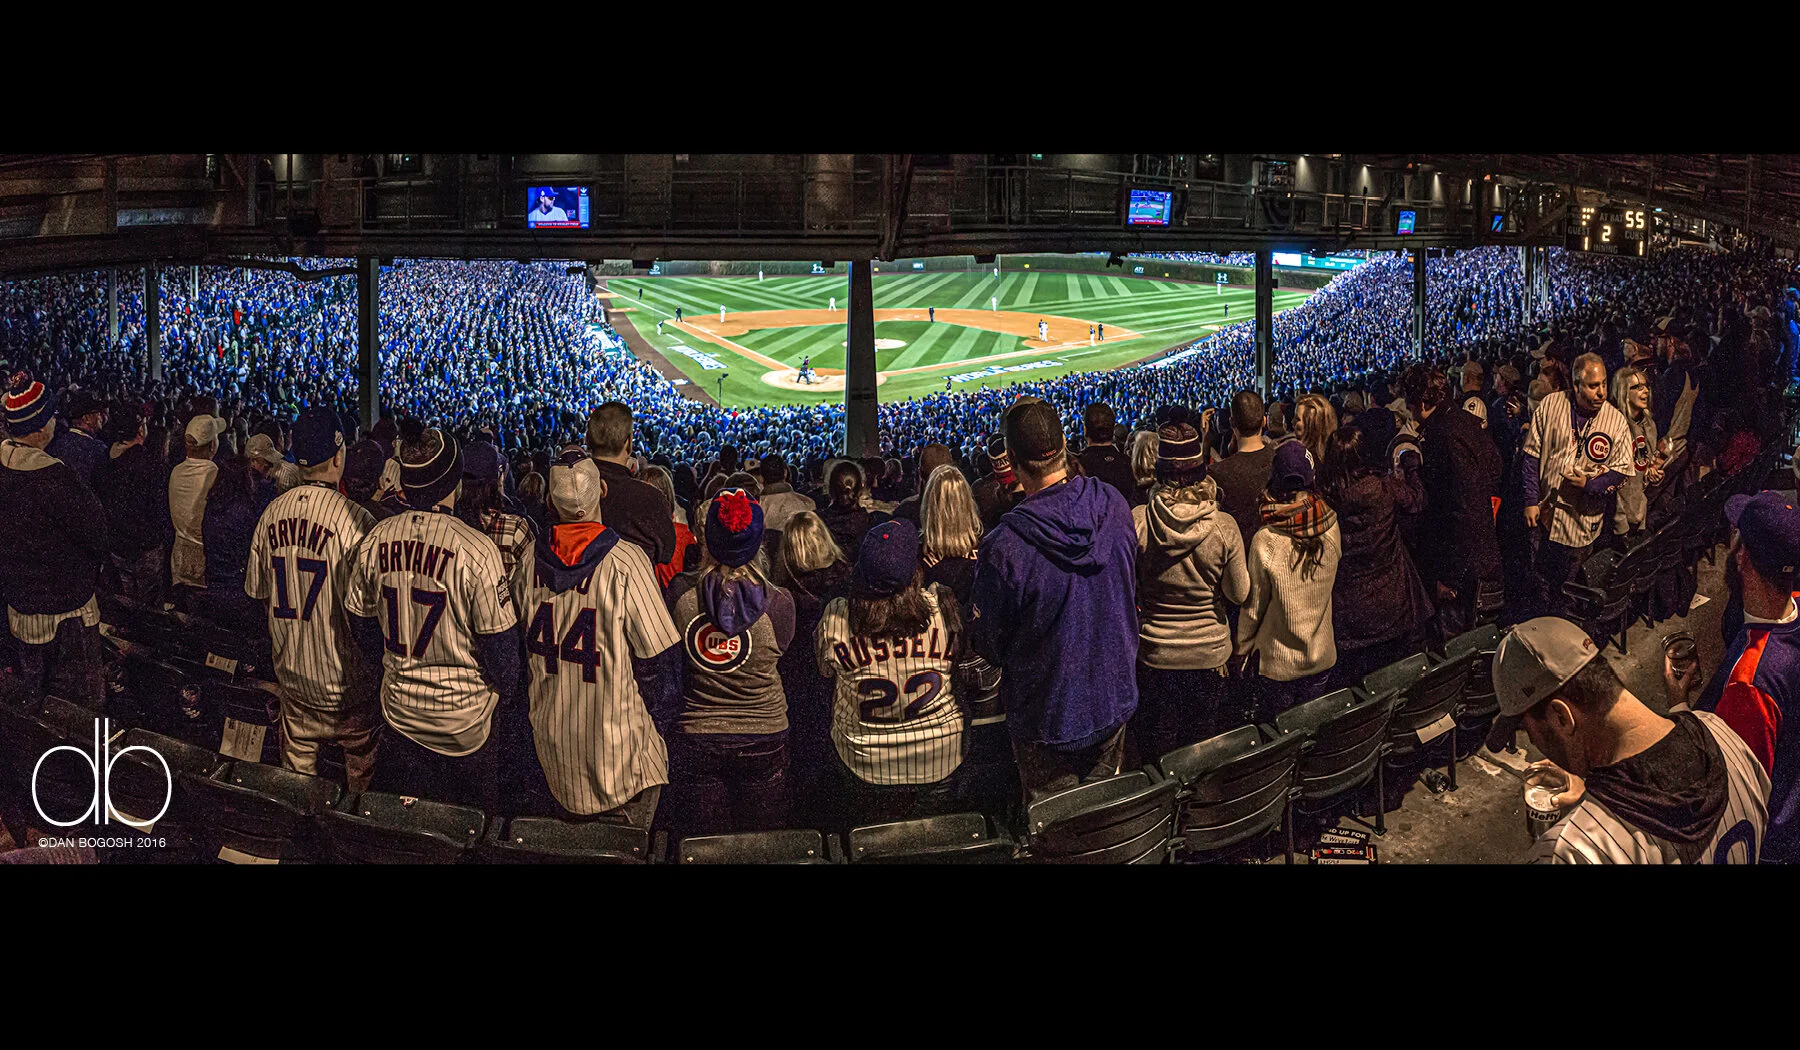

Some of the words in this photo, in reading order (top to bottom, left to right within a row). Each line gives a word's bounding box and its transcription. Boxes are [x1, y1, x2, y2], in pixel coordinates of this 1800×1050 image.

[1567, 226, 1590, 235] GUEST
[1601, 225, 1612, 242] 2
[1624, 231, 1645, 240] CUBS
[1625, 210, 1645, 229] 55
[1584, 236, 1589, 251] 1
[1639, 240, 1644, 256] 1
[1593, 243, 1618, 254] INNING
[268, 518, 334, 556] BRYANT
[379, 540, 455, 581] BRYANT
[271, 556, 328, 622] 17
[382, 584, 447, 660] 17
[527, 601, 601, 684] 44
[833, 628, 955, 672] RUSSELL
[858, 670, 943, 722] 22
[1530, 810, 1560, 821] Hefty
[1351, 831, 1367, 839] FOR
